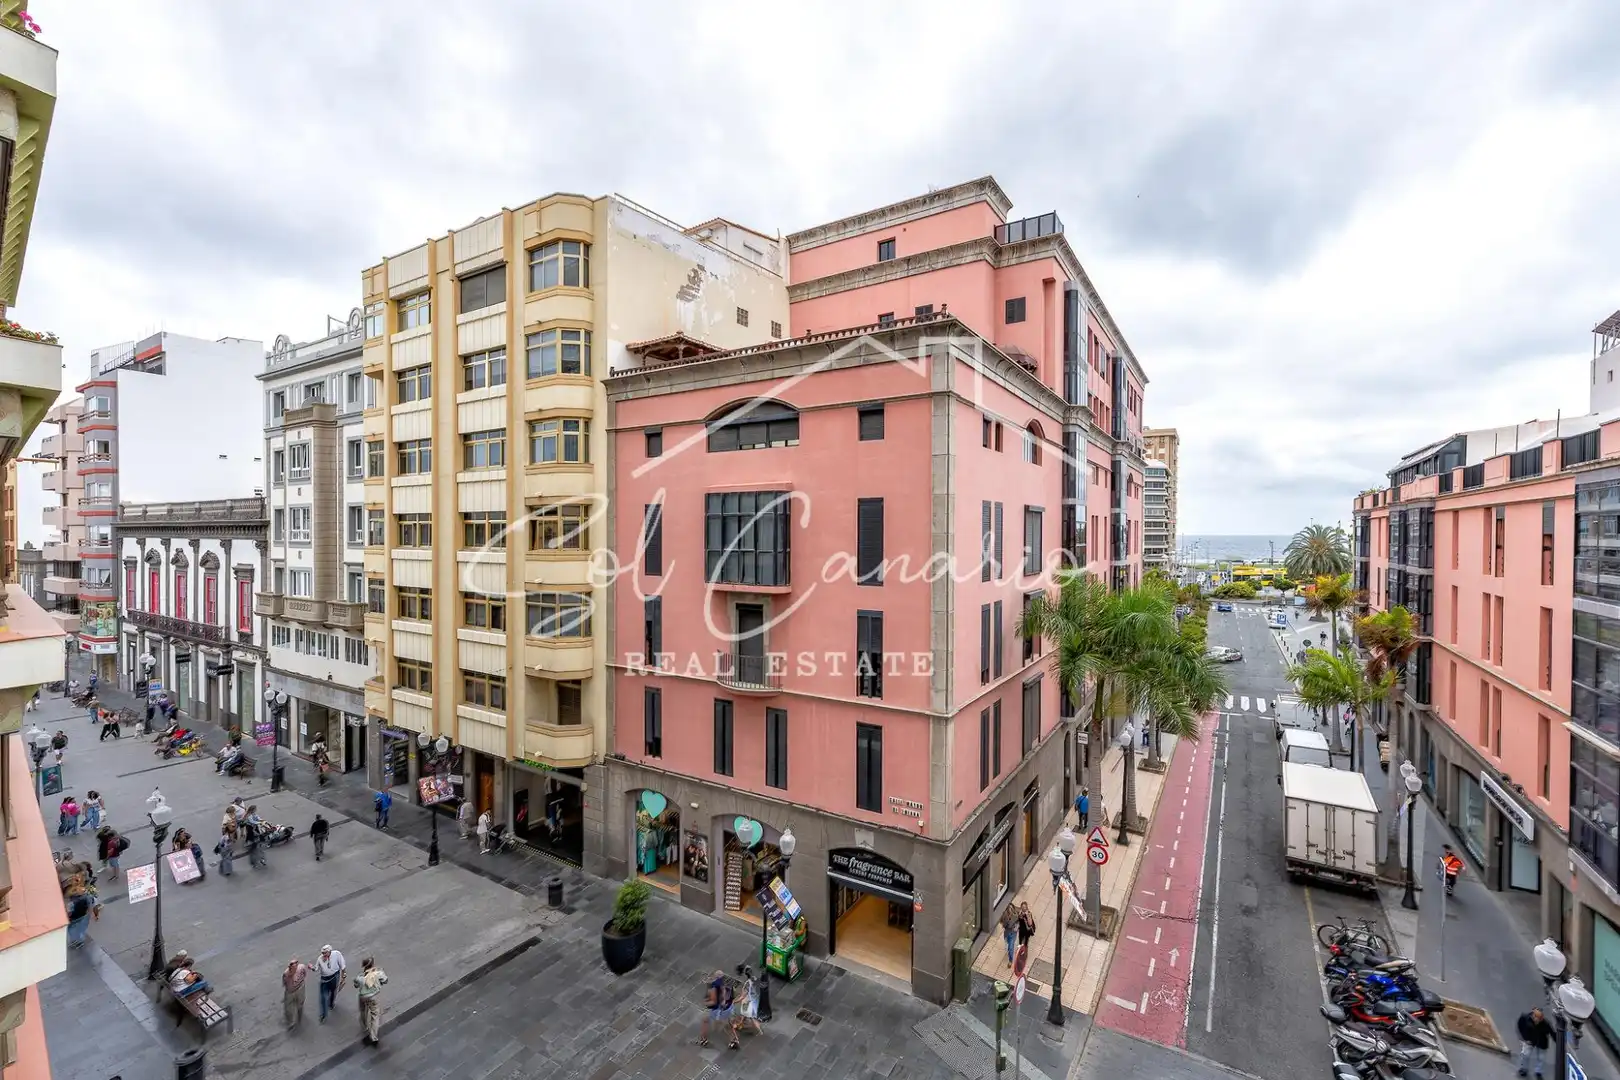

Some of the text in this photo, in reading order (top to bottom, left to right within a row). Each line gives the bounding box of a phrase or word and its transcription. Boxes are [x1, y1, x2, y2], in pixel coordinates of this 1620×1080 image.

[1092, 851, 1104, 859] 30
[832, 854, 849, 866] THE
[848, 856, 893, 878] fragrance
[893, 871, 911, 884] BAR
